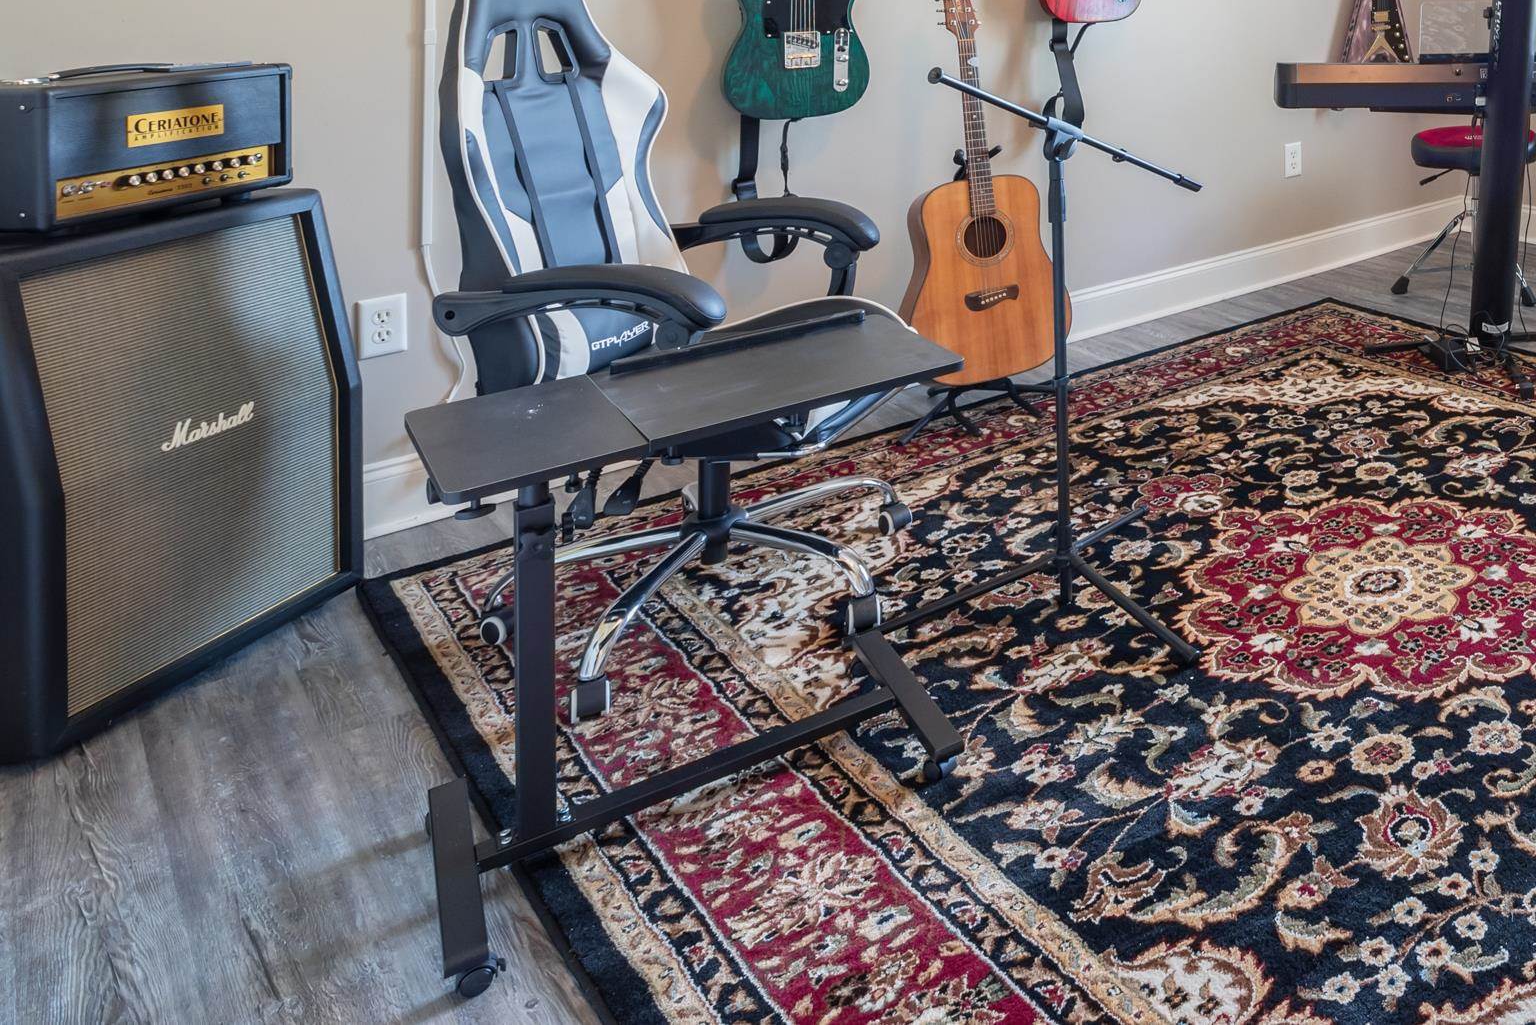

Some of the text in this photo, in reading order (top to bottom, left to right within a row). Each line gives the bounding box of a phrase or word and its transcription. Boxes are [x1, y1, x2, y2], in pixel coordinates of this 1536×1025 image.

[134, 111, 219, 134] CERIATONE
[134, 124, 219, 141] AMPLIFICATION
[591, 320, 650, 351] GTPLAYER
[160, 400, 255, 452] Marshall
